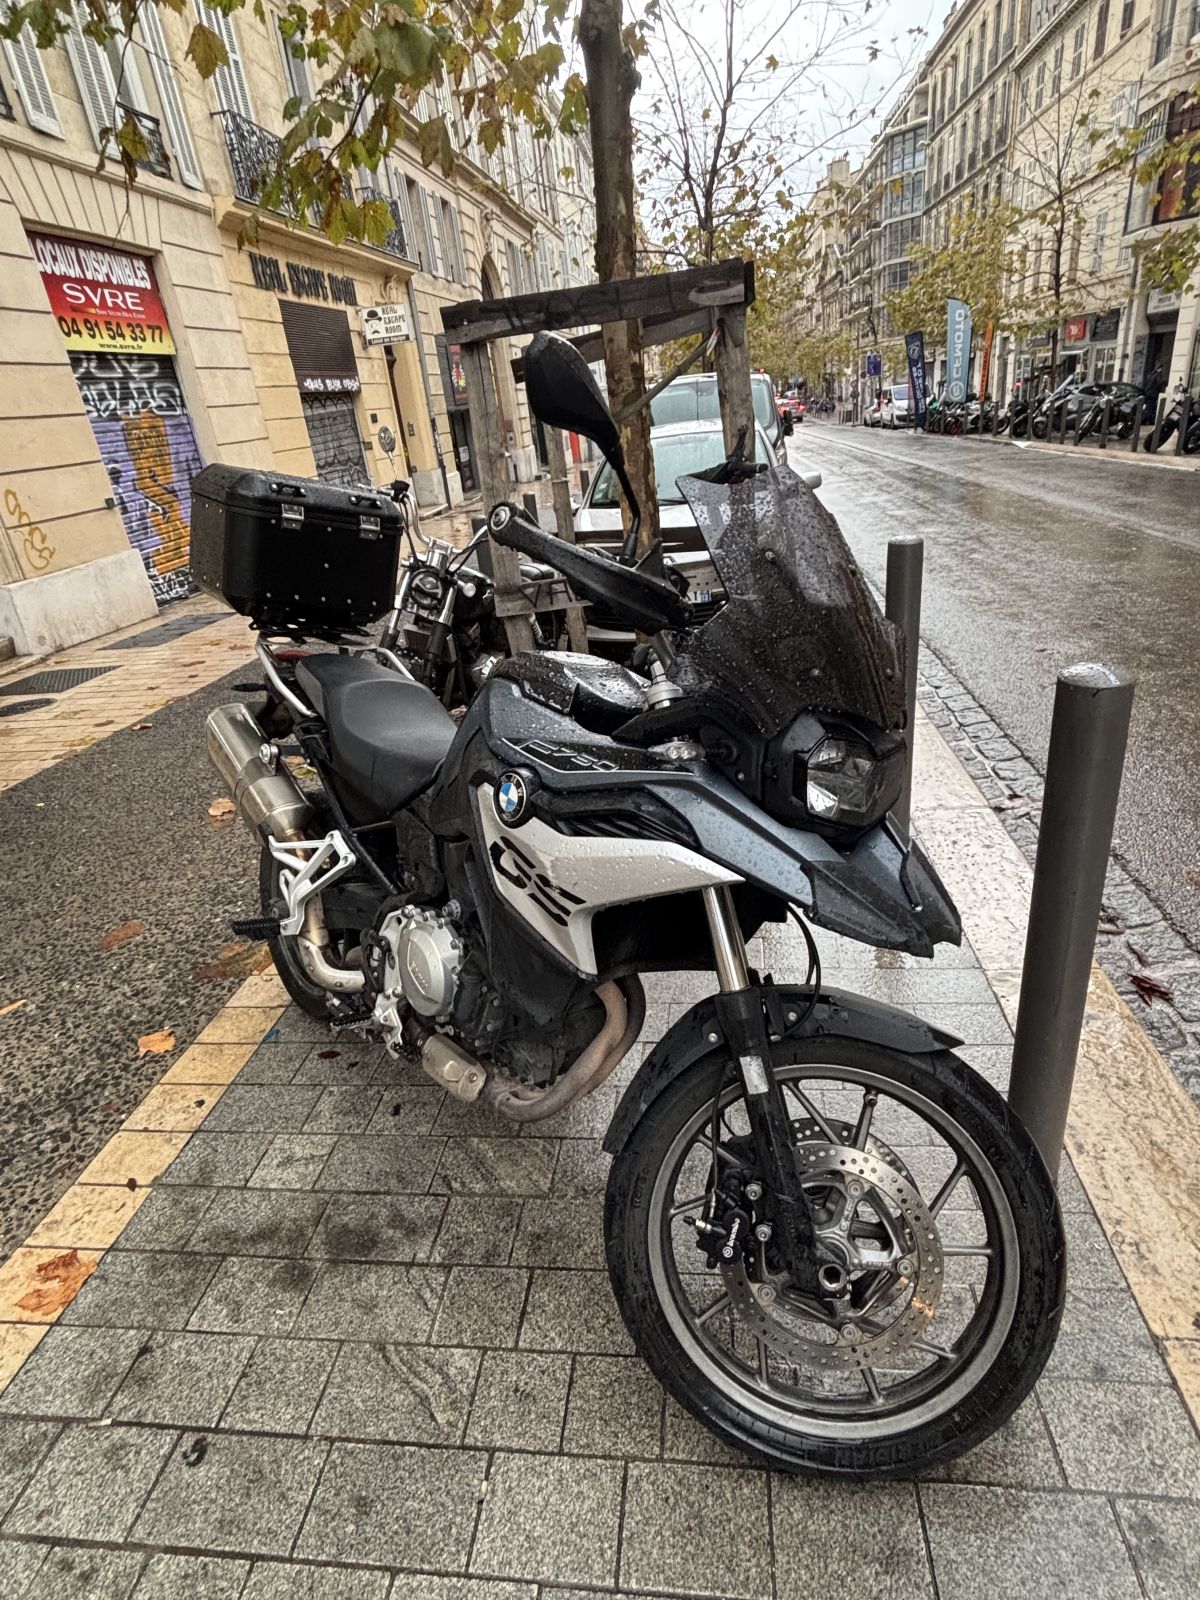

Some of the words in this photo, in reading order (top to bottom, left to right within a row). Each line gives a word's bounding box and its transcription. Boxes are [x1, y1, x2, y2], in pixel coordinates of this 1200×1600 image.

[78, 248, 152, 290] DISPONIBLES
[62, 282, 145, 311] SVRE
[381, 306, 398, 315] REAL
[57, 315, 83, 338] 04
[83, 318, 104, 340] 91
[104, 320, 126, 341] 54
[126, 322, 147, 343] 33
[146, 324, 164, 343] 77
[383, 314, 406, 325] ESCAPE
[385, 325, 402, 334] ROOM
[726, 1217, 741, 1247] brembo
